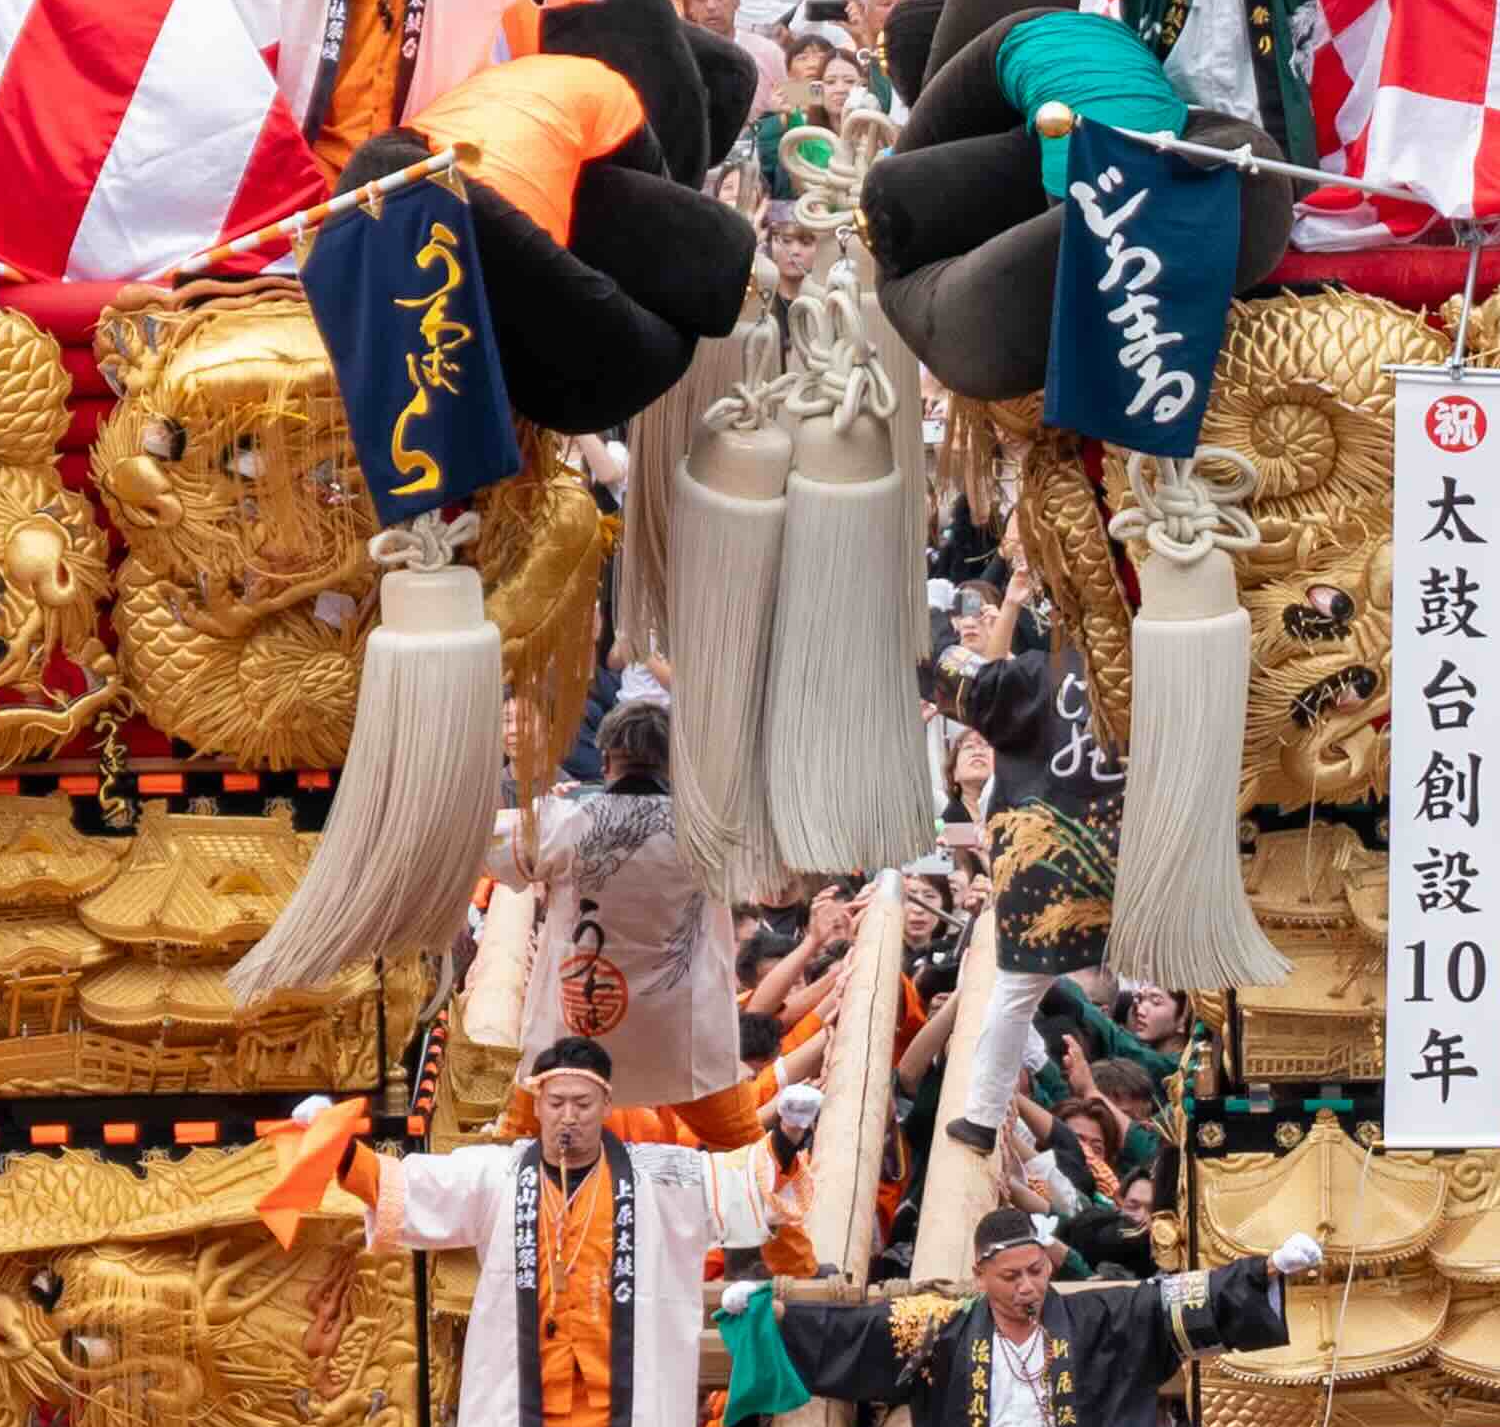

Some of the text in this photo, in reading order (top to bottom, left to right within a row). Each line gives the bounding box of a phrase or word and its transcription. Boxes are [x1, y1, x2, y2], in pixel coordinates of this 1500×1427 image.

[1432, 399, 1481, 449] 祝
[1405, 476, 1486, 1103] 太鼓台創設10年
